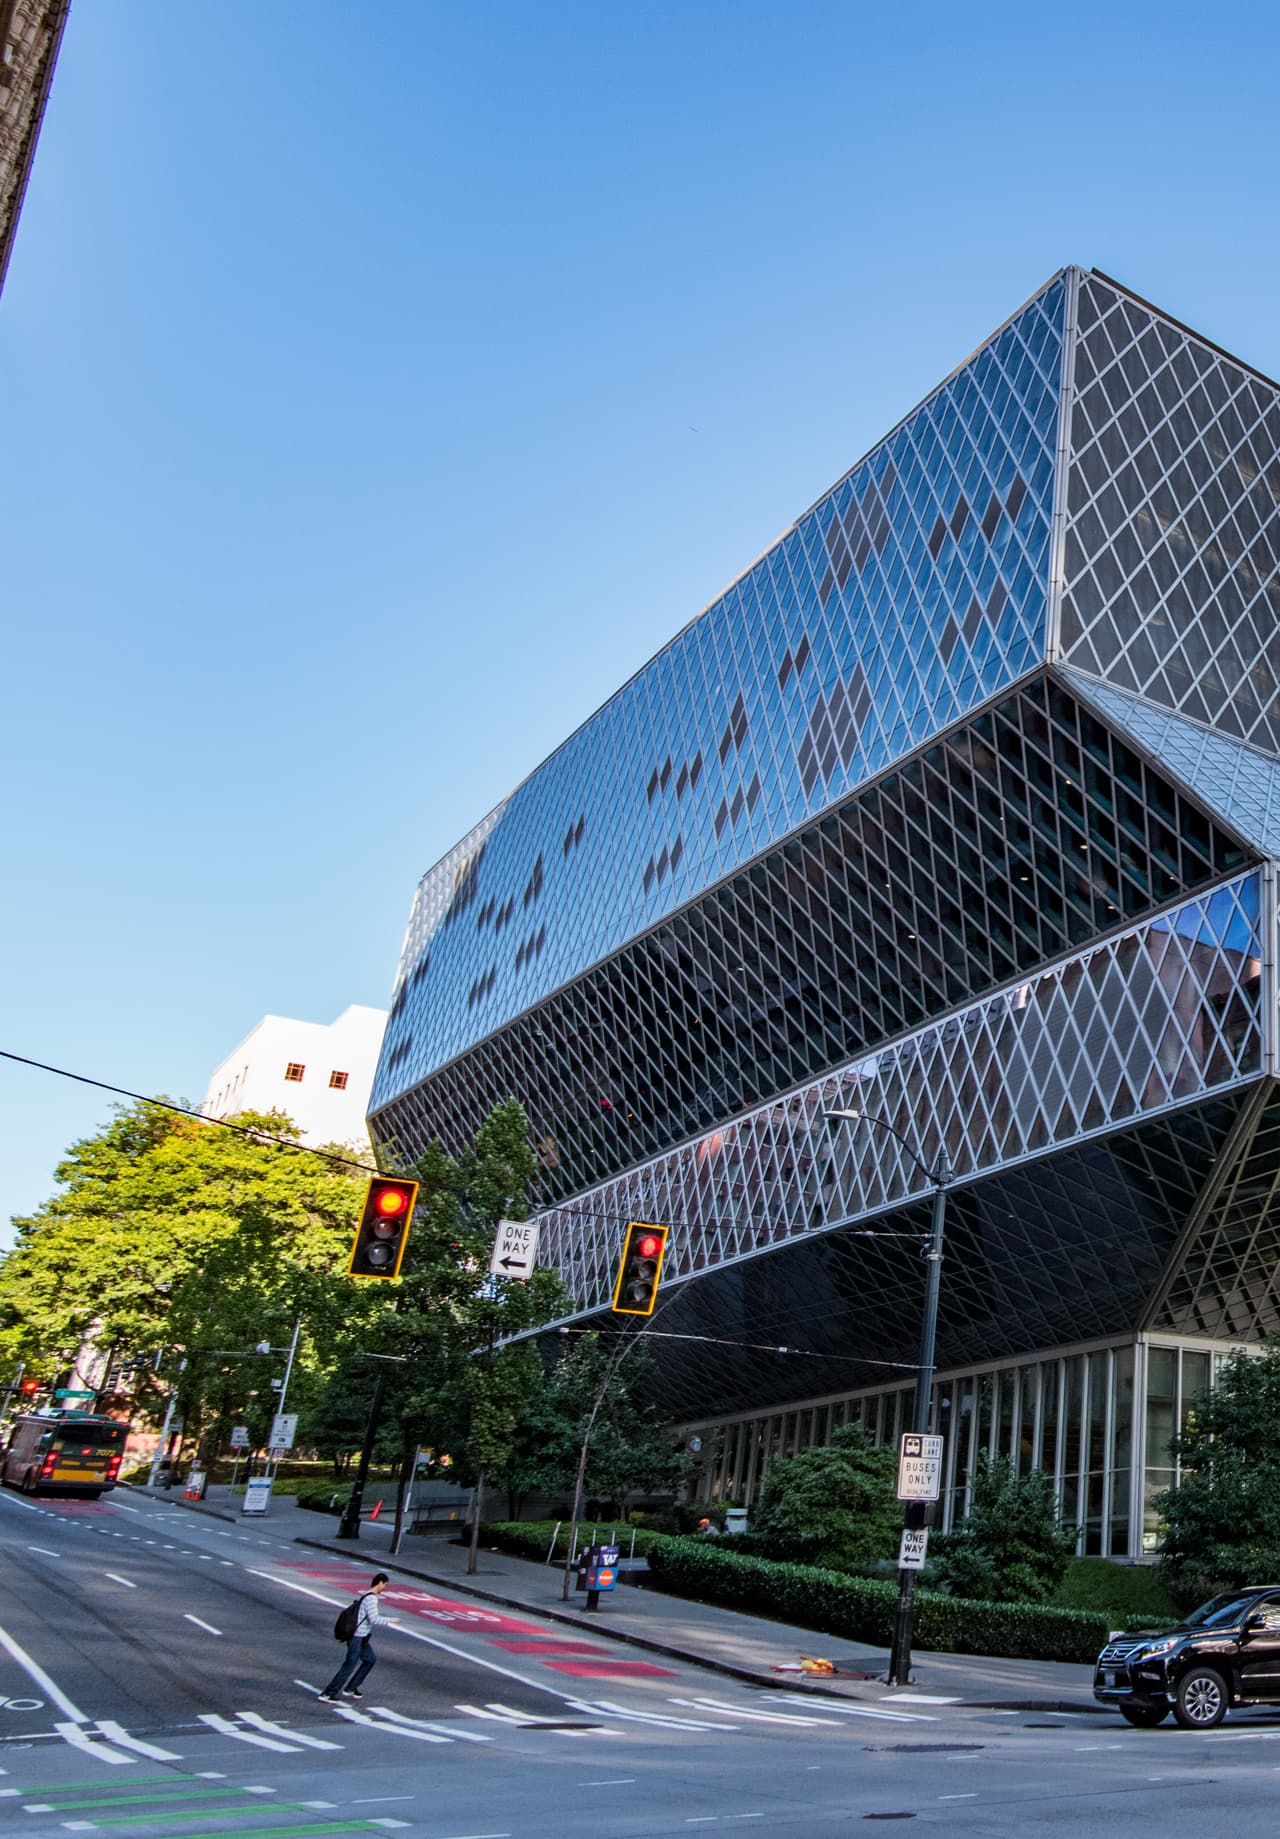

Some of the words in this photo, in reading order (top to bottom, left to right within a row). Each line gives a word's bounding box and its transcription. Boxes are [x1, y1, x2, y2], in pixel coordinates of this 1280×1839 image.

[506, 1226, 531, 1241] ONE
[503, 1240, 530, 1255] WAY
[906, 1462, 936, 1473] BUSES
[908, 1474, 932, 1485] ONLY
[905, 1532, 925, 1543] ONE
[904, 1543, 924, 1553] WAY
[420, 1609, 501, 1622] BUS
